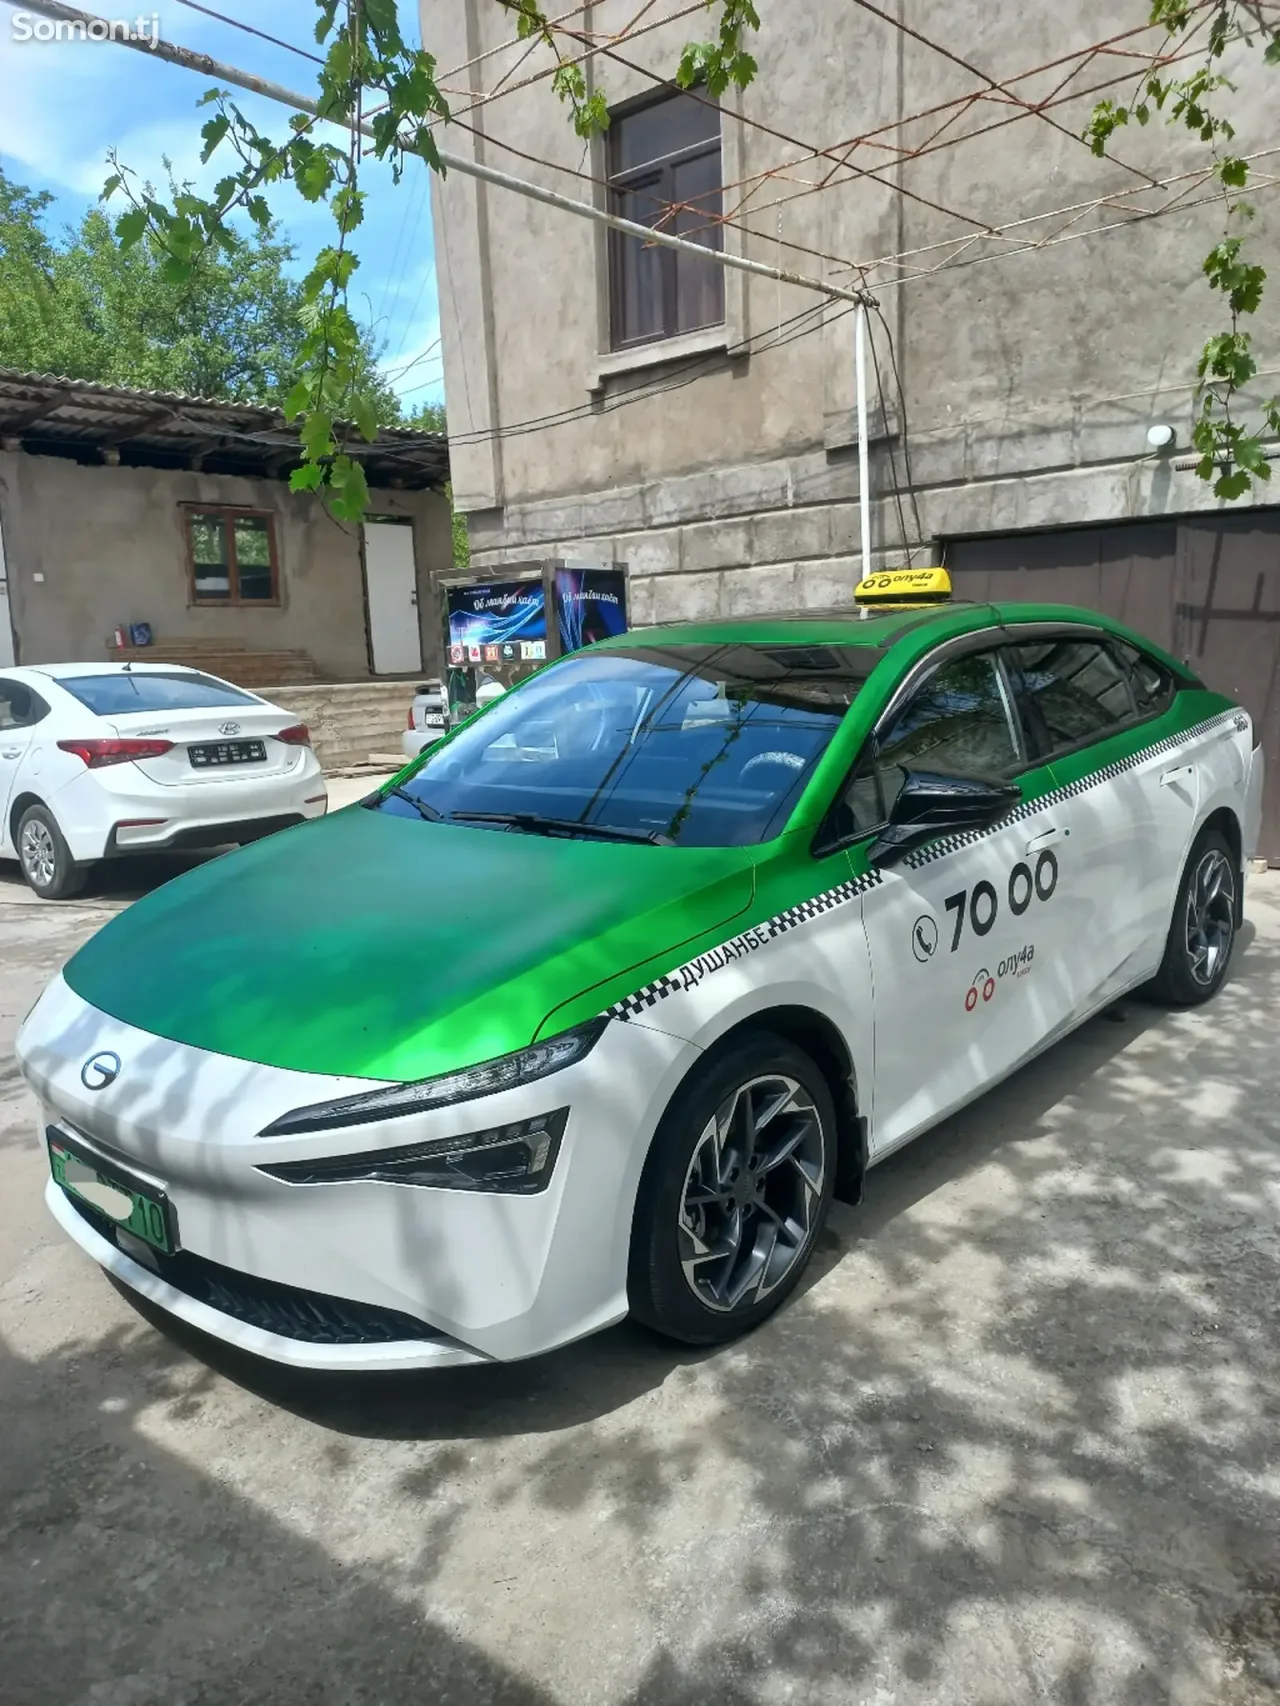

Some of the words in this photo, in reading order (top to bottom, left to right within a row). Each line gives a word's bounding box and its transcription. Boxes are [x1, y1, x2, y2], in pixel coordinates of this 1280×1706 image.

[944, 880, 998, 953] 70
[1008, 850, 1058, 916] 00
[679, 926, 770, 991] ДУШАНБЕ
